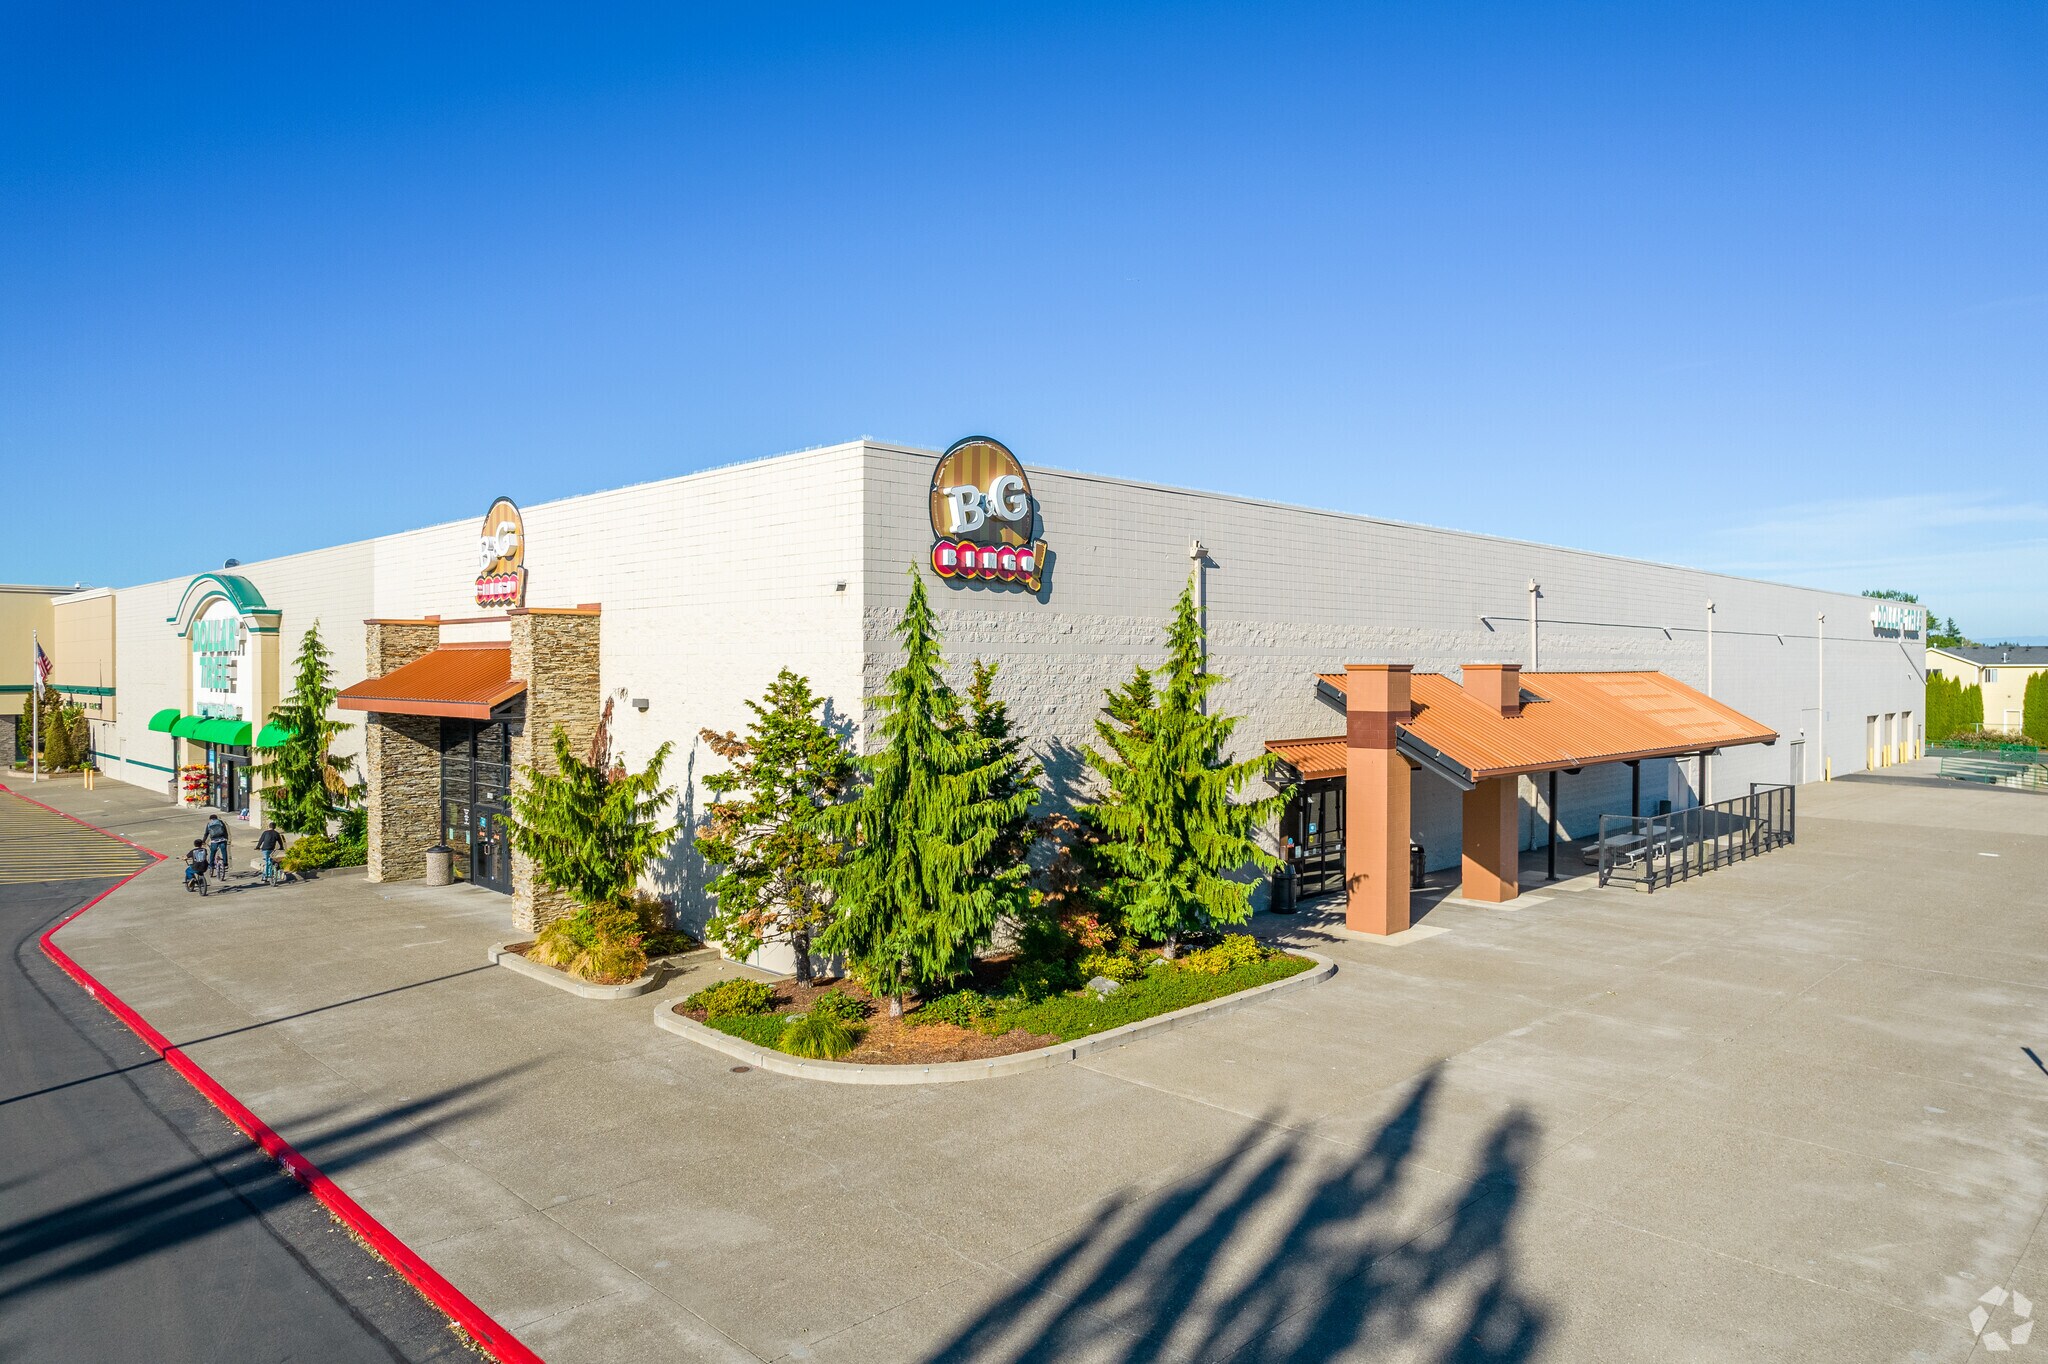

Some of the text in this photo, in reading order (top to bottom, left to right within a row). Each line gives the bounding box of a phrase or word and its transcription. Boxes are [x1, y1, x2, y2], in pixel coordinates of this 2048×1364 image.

[943, 474, 1028, 534] B&G
[1875, 605, 1903, 630] DOLLAR
[193, 618, 239, 652] DOLLAR
[200, 656, 231, 689] TREE
